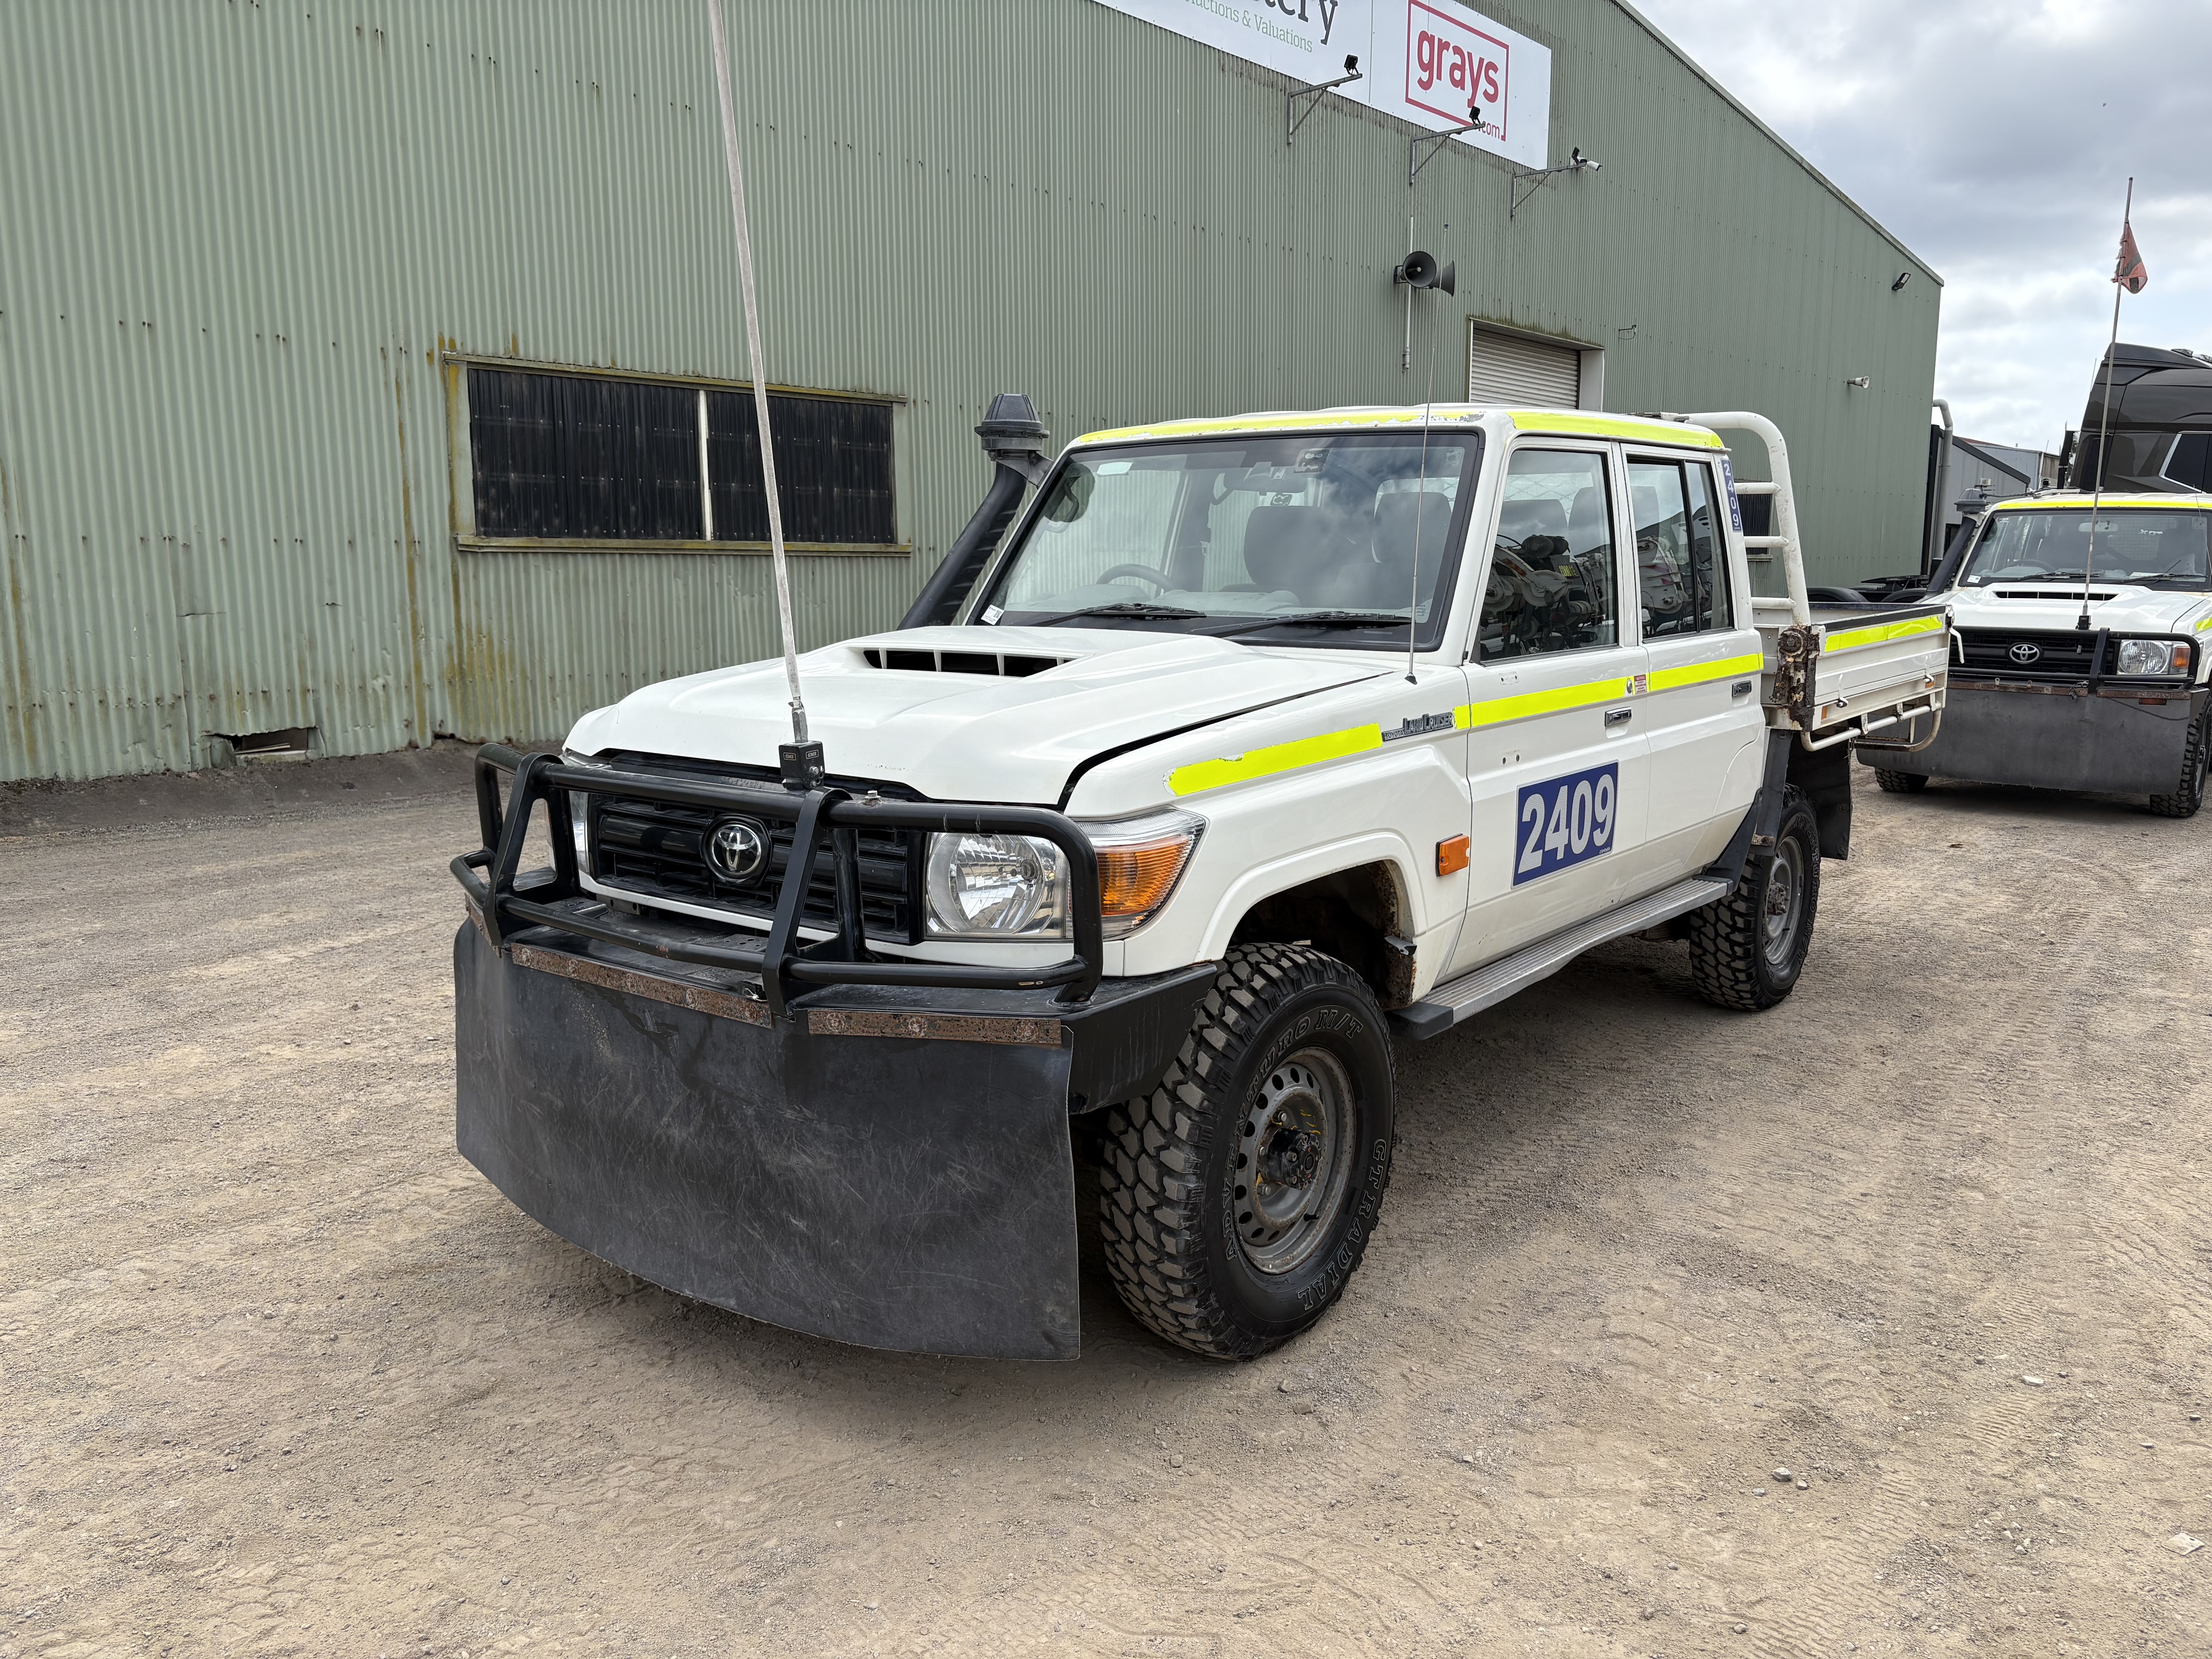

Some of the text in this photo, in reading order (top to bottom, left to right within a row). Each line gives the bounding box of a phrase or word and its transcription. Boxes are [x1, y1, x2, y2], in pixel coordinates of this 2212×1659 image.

[1242, 10, 1251, 28] &
[1254, 14, 1312, 52] Valuations
[1417, 30, 1499, 108] grays
[1724, 463, 1739, 526] 2409
[1384, 729, 1405, 739] TOYOTA
[1518, 774, 1614, 874] 2409
[1316, 1009, 1364, 1039] M/T
